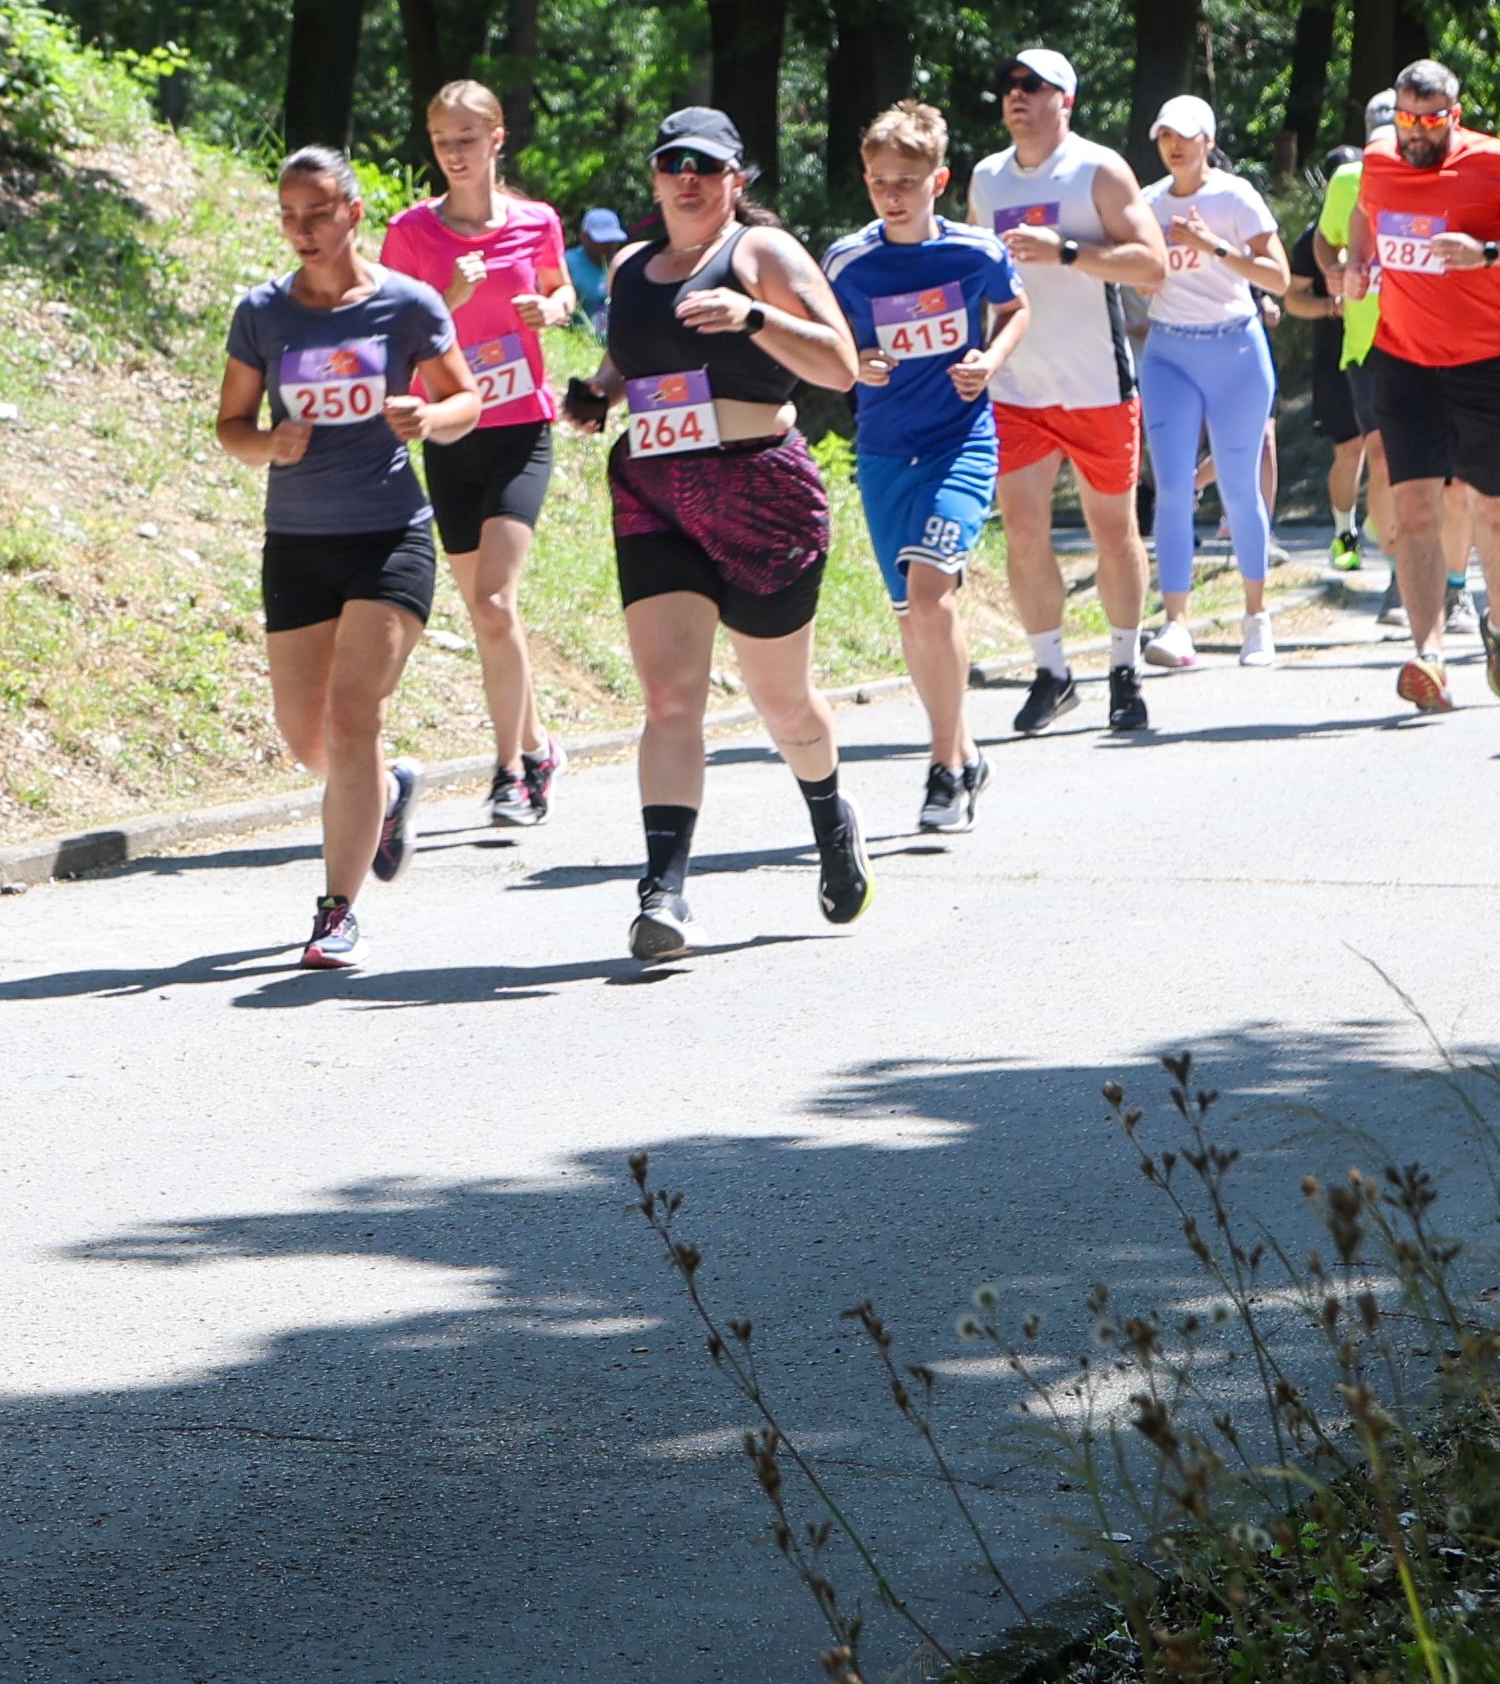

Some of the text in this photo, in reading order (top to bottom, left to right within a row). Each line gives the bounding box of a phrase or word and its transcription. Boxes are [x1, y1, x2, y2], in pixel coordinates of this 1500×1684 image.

[891, 318, 959, 352] 415
[296, 384, 372, 420] 250
[478, 367, 516, 403] 27
[636, 411, 704, 450] 264
